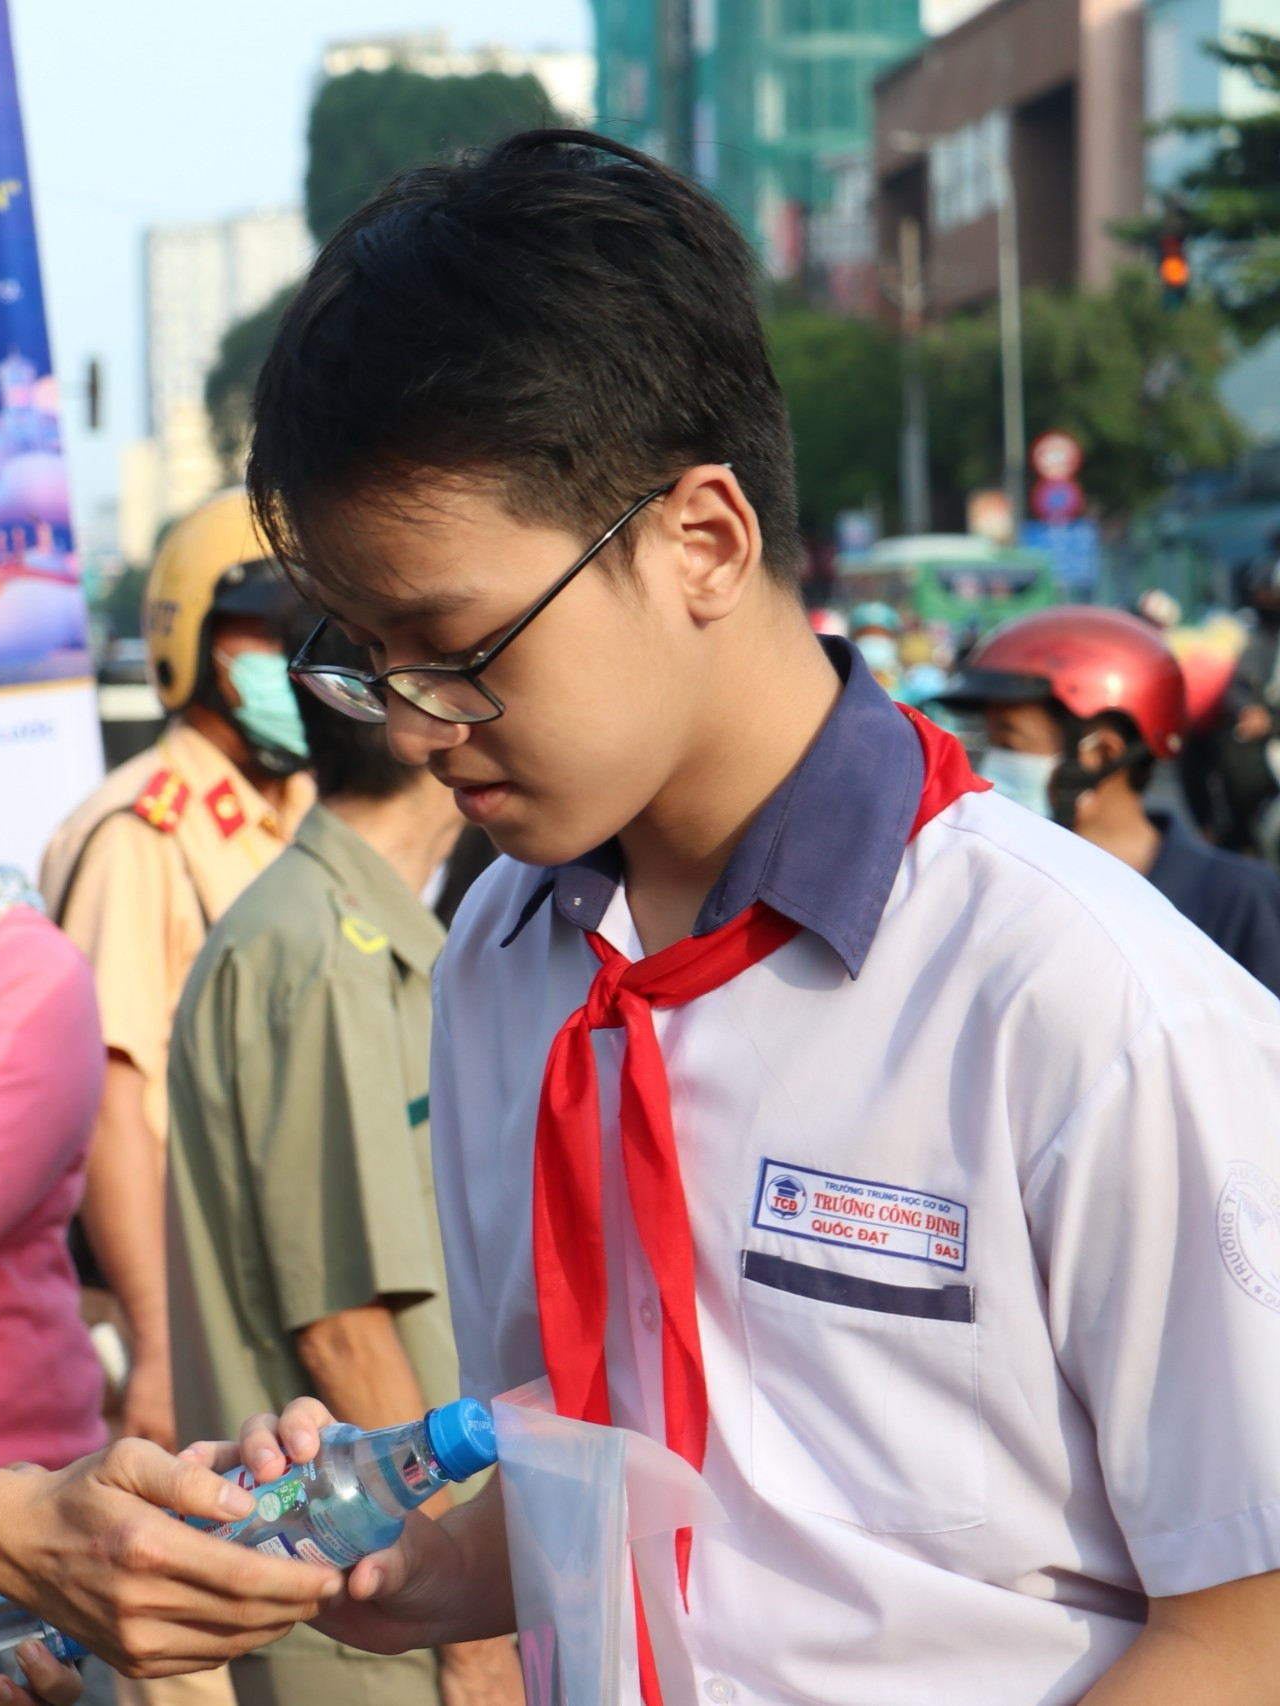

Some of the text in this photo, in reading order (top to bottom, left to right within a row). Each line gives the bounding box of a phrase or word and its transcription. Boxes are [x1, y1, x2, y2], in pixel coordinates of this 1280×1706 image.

[867, 1189, 898, 1201] TRUNG
[901, 1195, 920, 1207] HỌC
[814, 1193, 960, 1238] TRƯƠNG CÔNG ĐỊNH
[811, 1218, 889, 1246] QUỐC ĐẠT
[935, 1243, 960, 1260] 9A3
